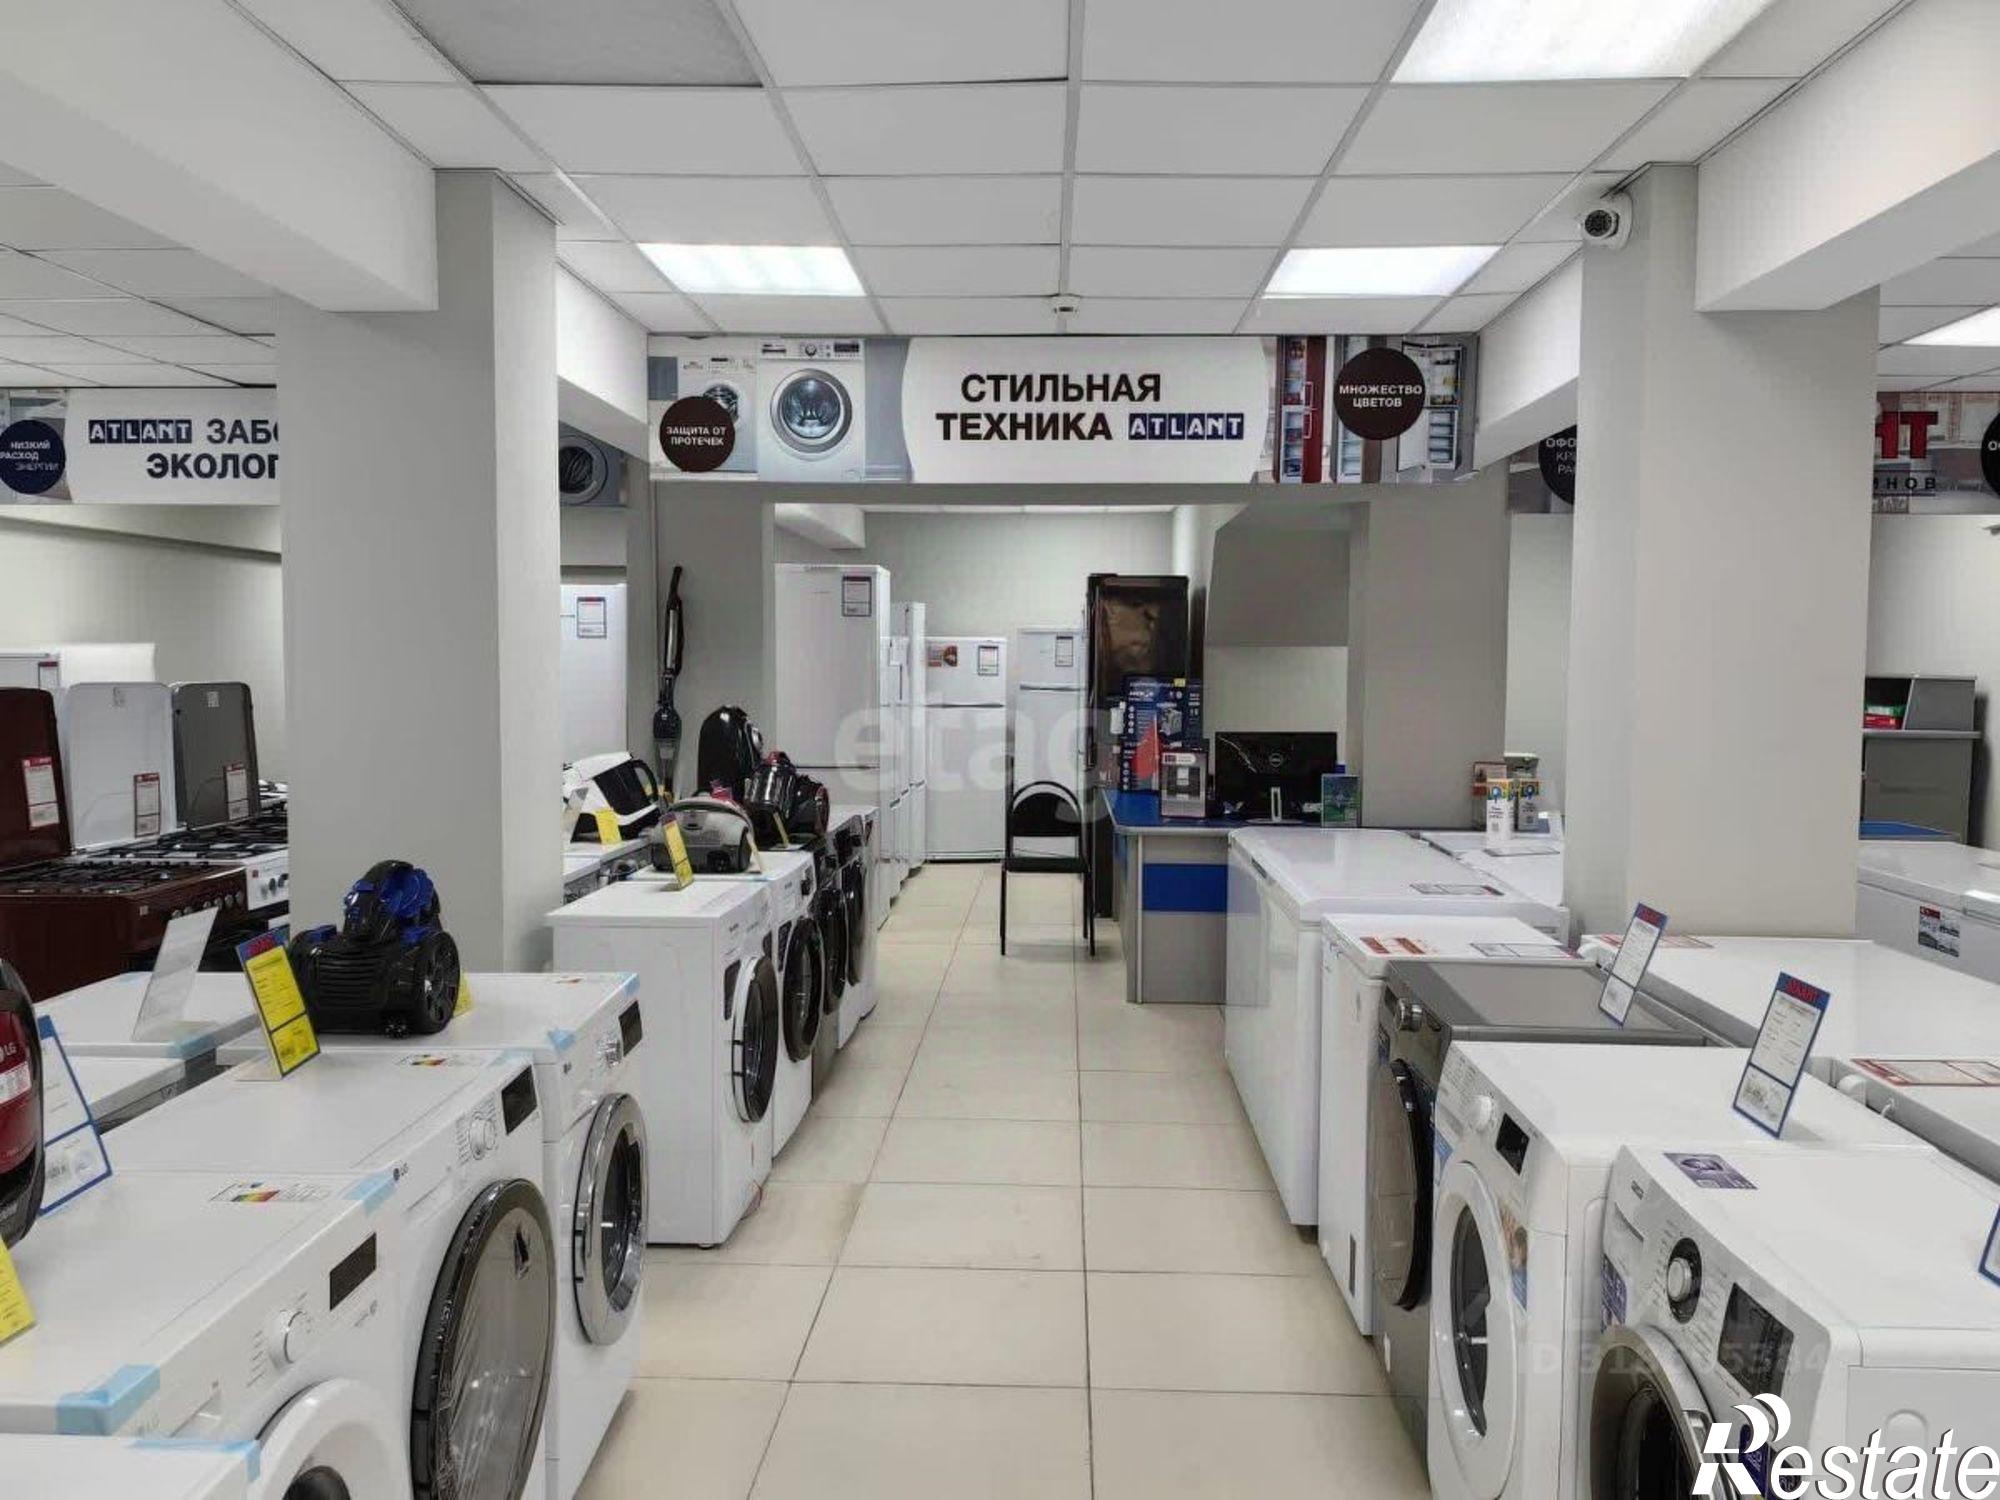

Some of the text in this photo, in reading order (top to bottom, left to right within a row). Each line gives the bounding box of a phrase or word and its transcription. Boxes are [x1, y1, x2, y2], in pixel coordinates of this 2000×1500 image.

[961, 373, 1161, 403] СТИЛЬНАЯ
[1338, 384, 1424, 396] МНОЖЕСТВО
[1352, 397, 1403, 408] ЦВЕТОВ
[89, 418, 279, 444] ATLANT ЗАБ
[666, 426, 726, 436] ЗАЩИТА ОТ
[935, 412, 1244, 441] ТЕХНИКА ATLANT
[11, 440, 51, 449] НИЗКИЙ
[671, 436, 725, 446] ПРОТЕЧЕК
